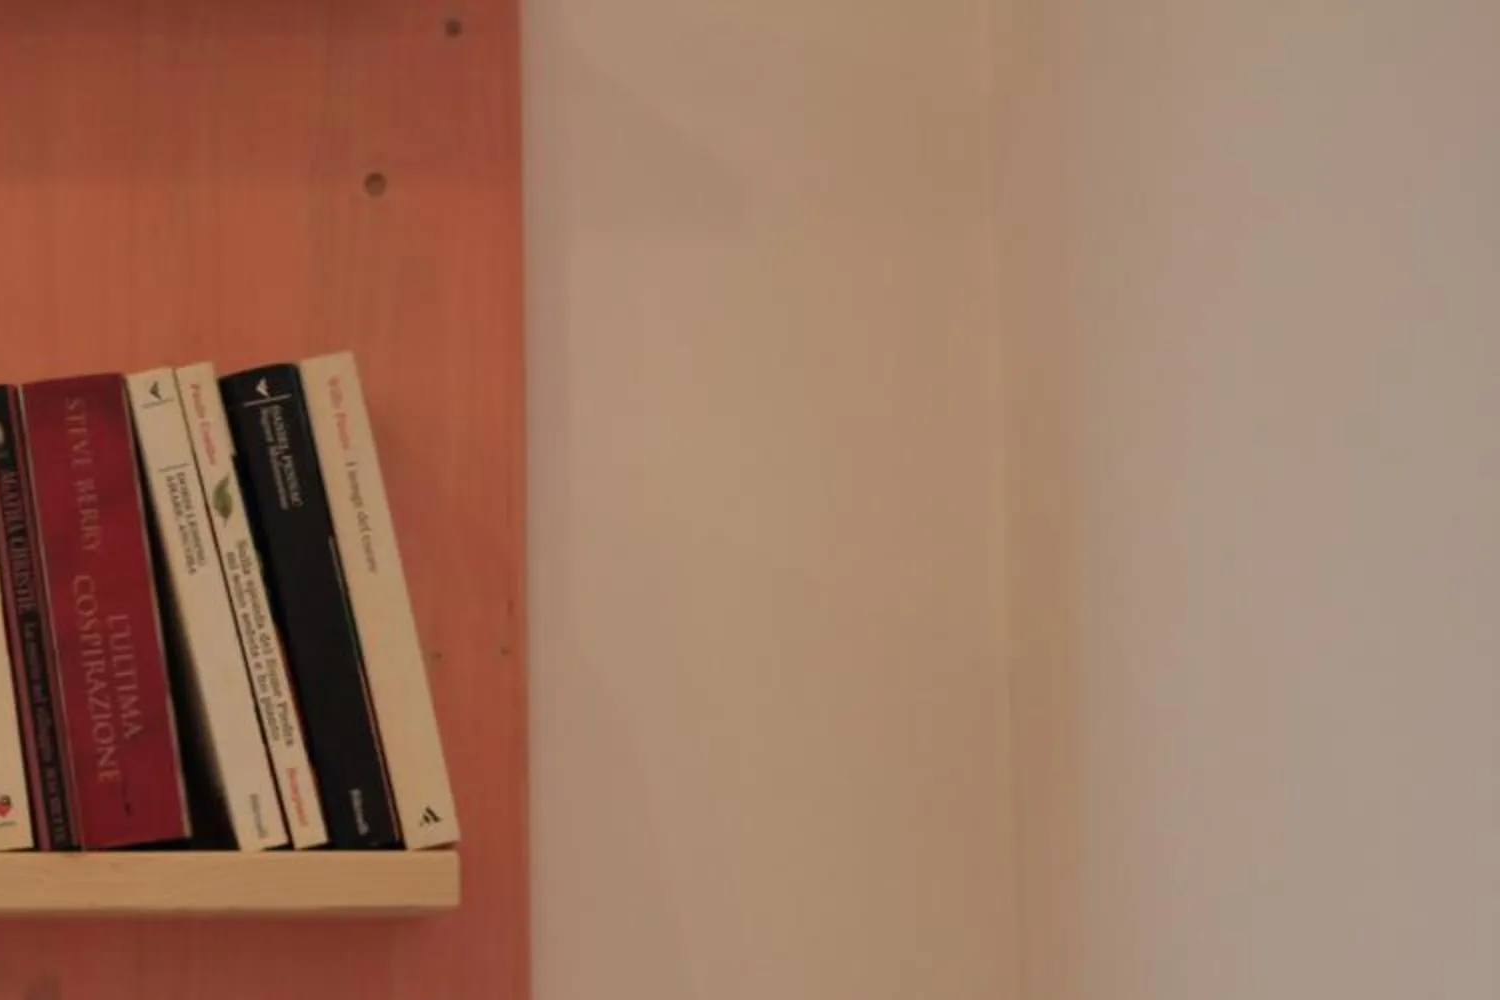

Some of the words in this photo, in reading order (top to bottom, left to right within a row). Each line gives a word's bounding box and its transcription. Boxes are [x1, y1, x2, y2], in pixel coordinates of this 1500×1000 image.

[62, 395, 93, 468] STEVE
[73, 476, 104, 553] BERRY
[69, 572, 122, 784] COSPIRAZIONE
[104, 611, 145, 740] L'ULTIMA
